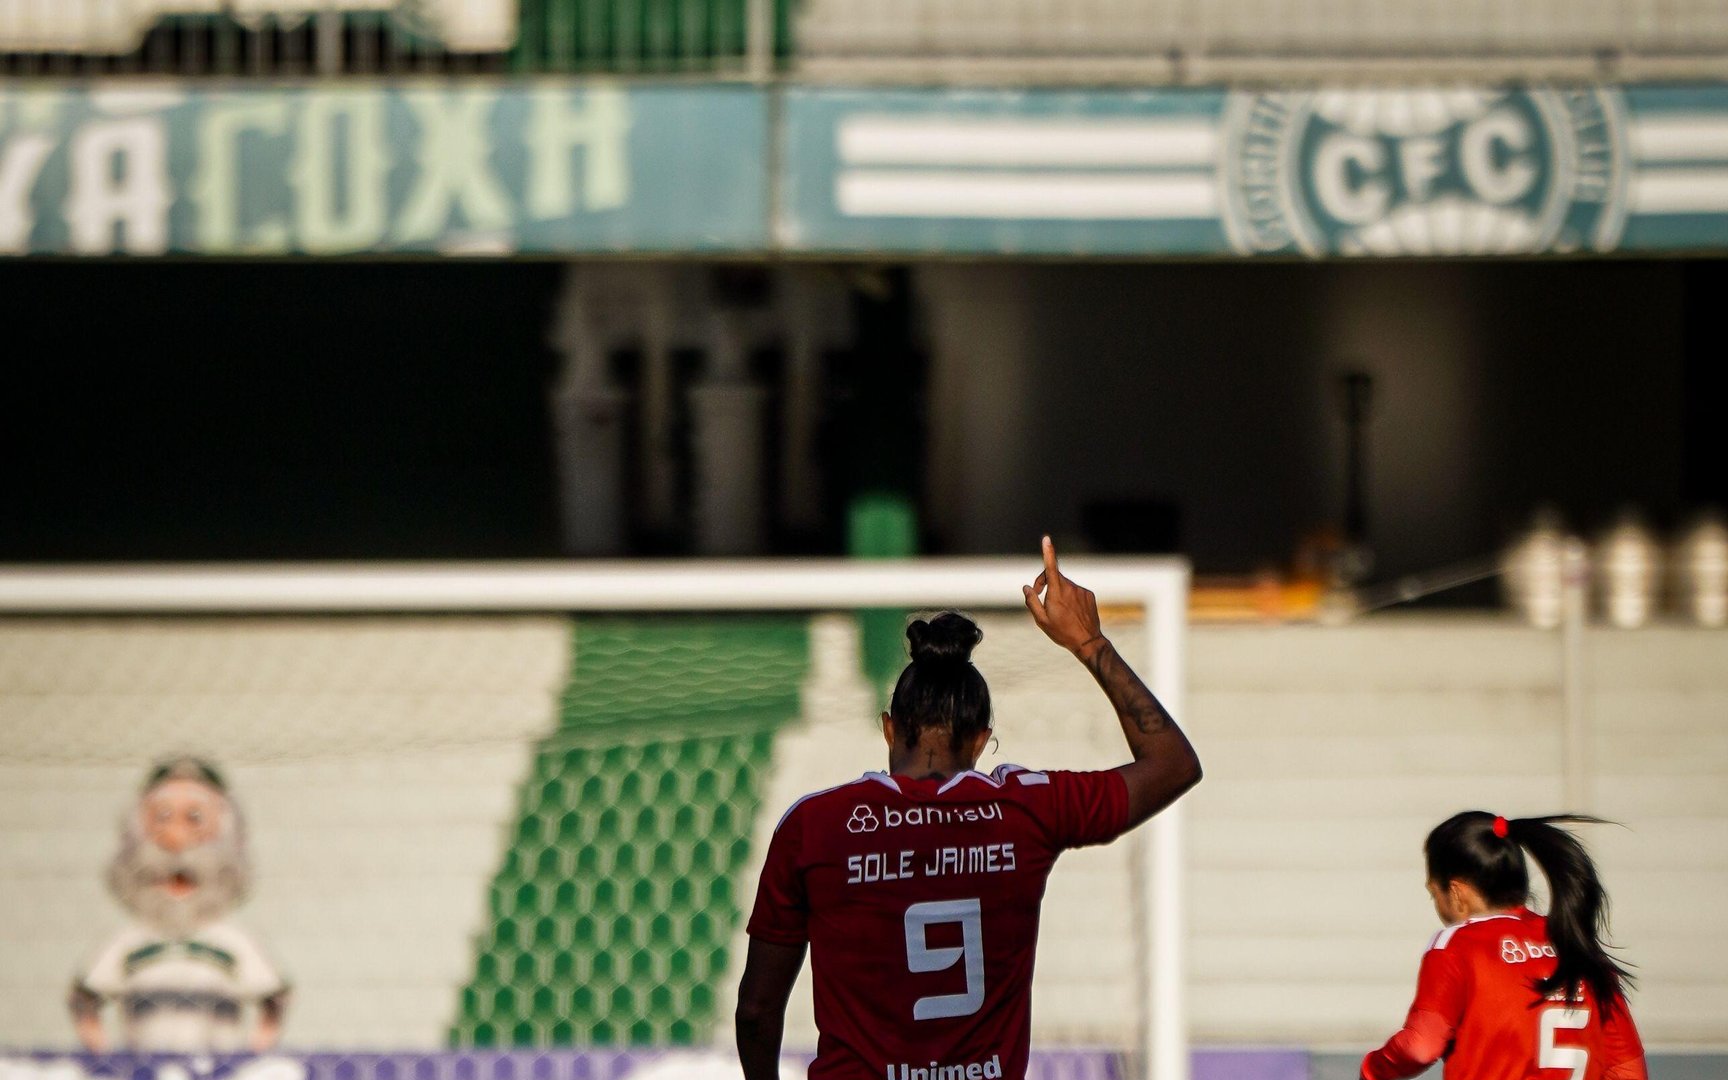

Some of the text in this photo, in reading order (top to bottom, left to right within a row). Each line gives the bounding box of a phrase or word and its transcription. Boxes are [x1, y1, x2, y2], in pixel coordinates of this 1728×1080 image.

[1313, 106, 1540, 225] CFC
[884, 802, 1003, 828] banrisul
[847, 843, 1016, 884] SOLE JAIMES
[904, 898, 985, 1021] 9
